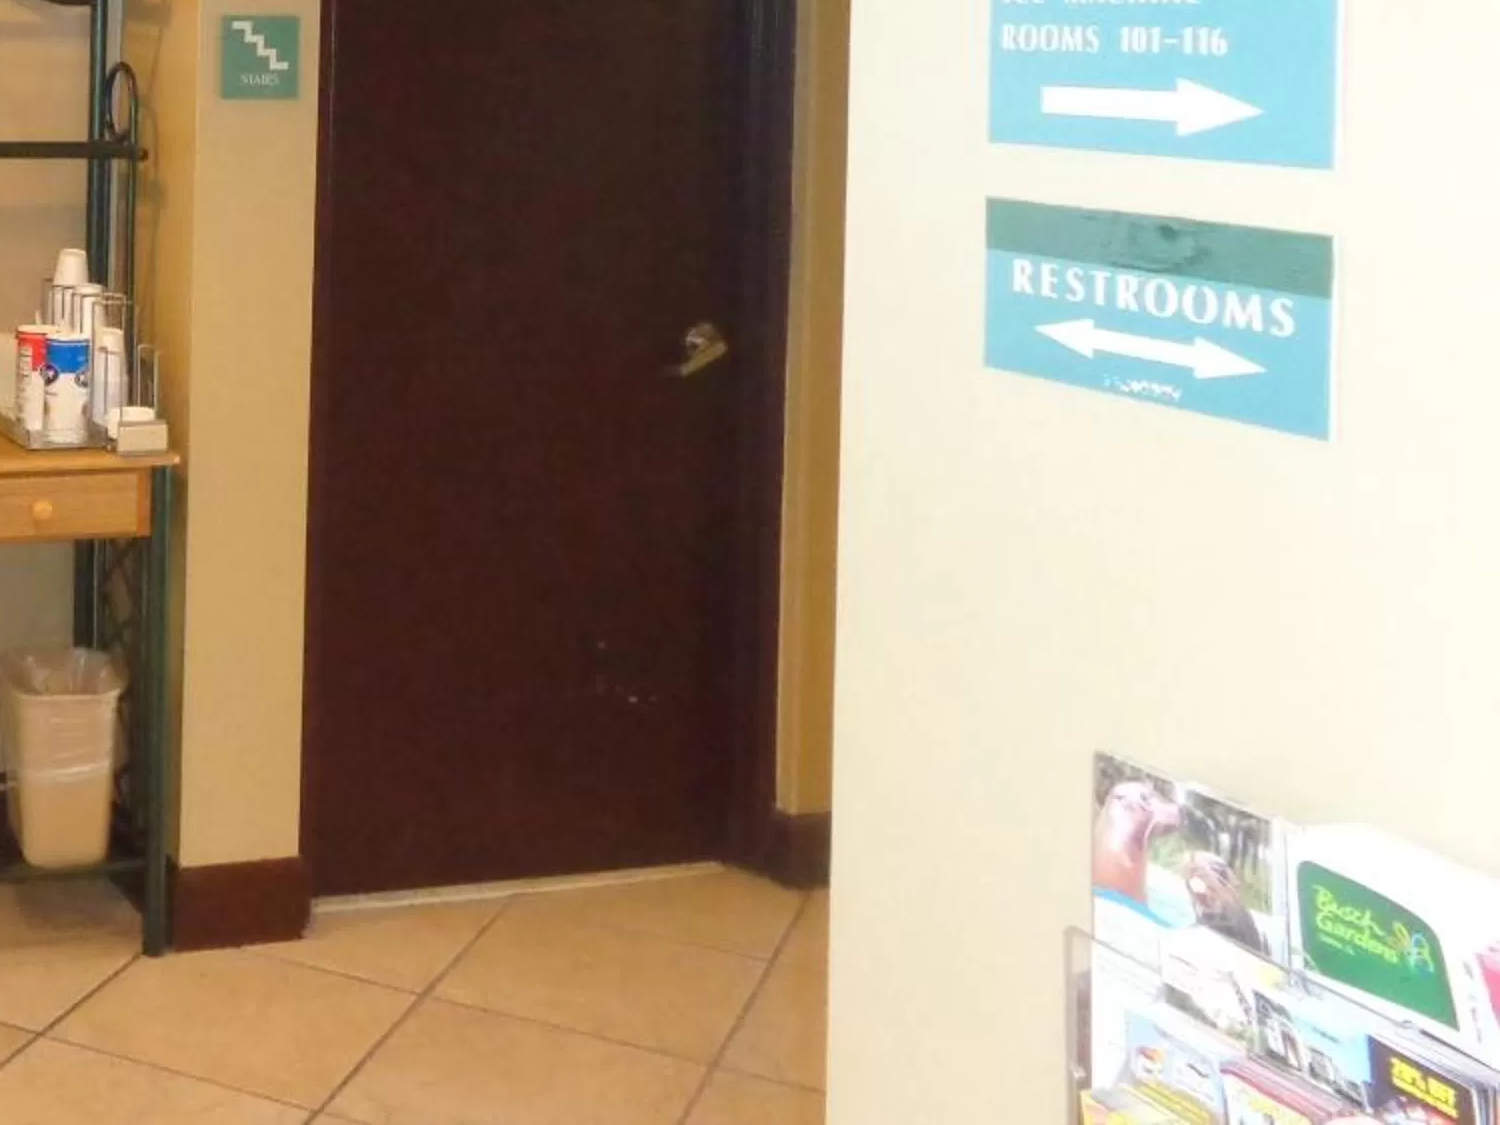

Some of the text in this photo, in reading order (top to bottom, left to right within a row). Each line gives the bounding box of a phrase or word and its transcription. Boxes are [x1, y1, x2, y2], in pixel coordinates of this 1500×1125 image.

[1002, 23, 1229, 57] ROOMS 101-116
[1012, 258, 1296, 339] RESTROOMS
